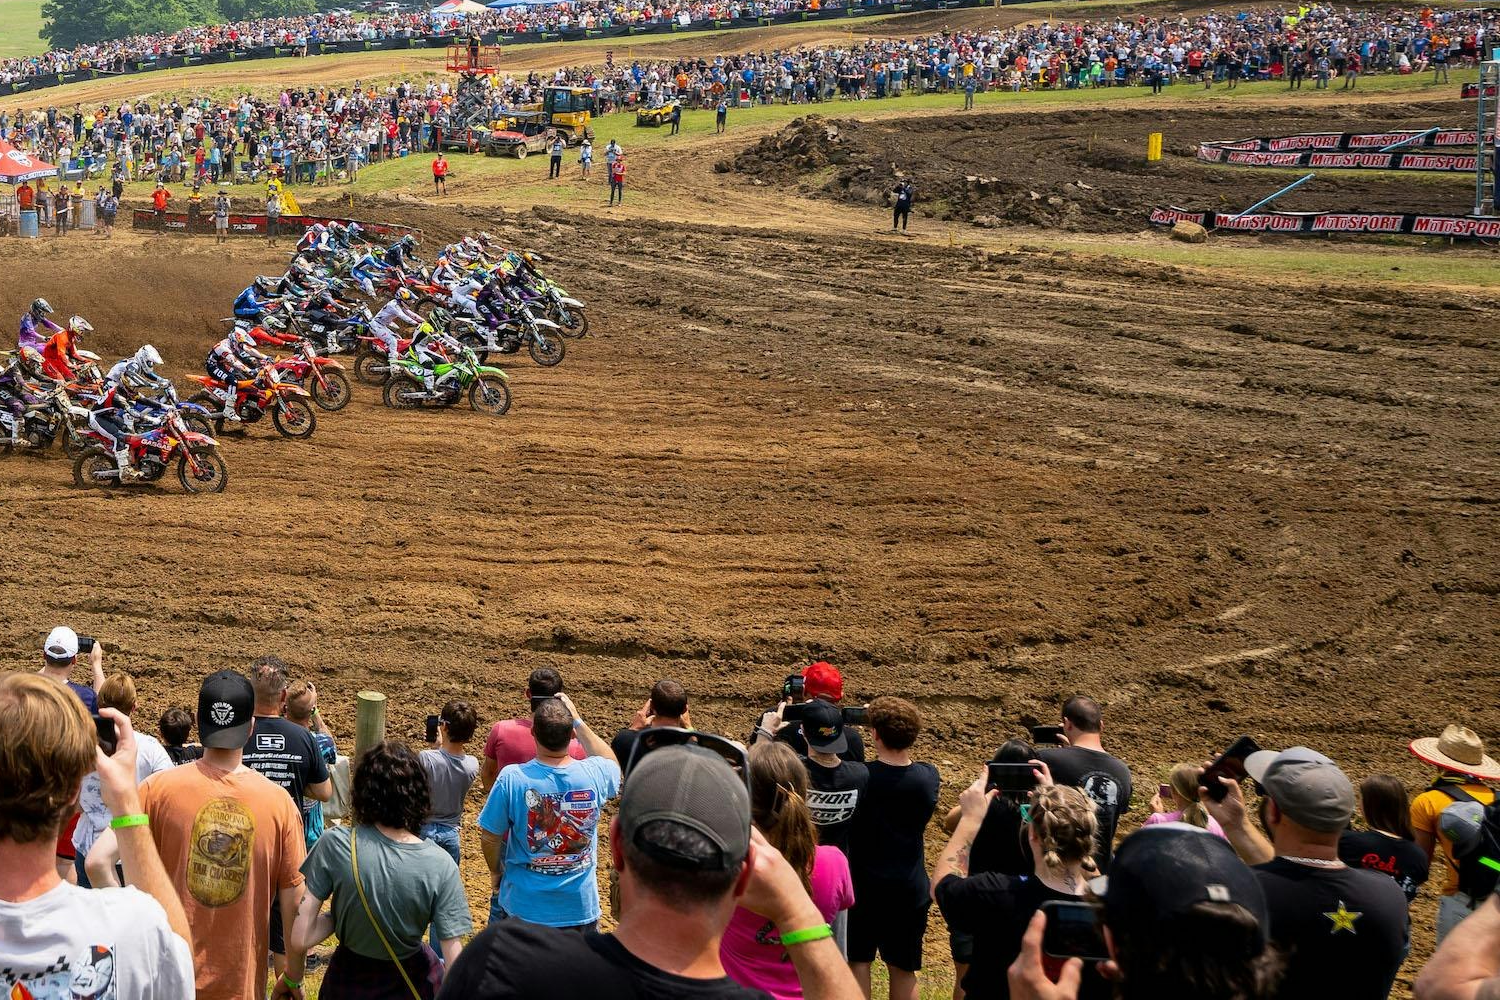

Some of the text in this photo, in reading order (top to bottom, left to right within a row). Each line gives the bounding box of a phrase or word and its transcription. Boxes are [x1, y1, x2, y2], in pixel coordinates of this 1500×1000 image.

[409, 366, 423, 377] 30
[140, 438, 172, 452] GASGAS
[808, 792, 853, 805] THOR
[210, 811, 246, 825] CAROLINA
[209, 866, 244, 882] CHASERS
